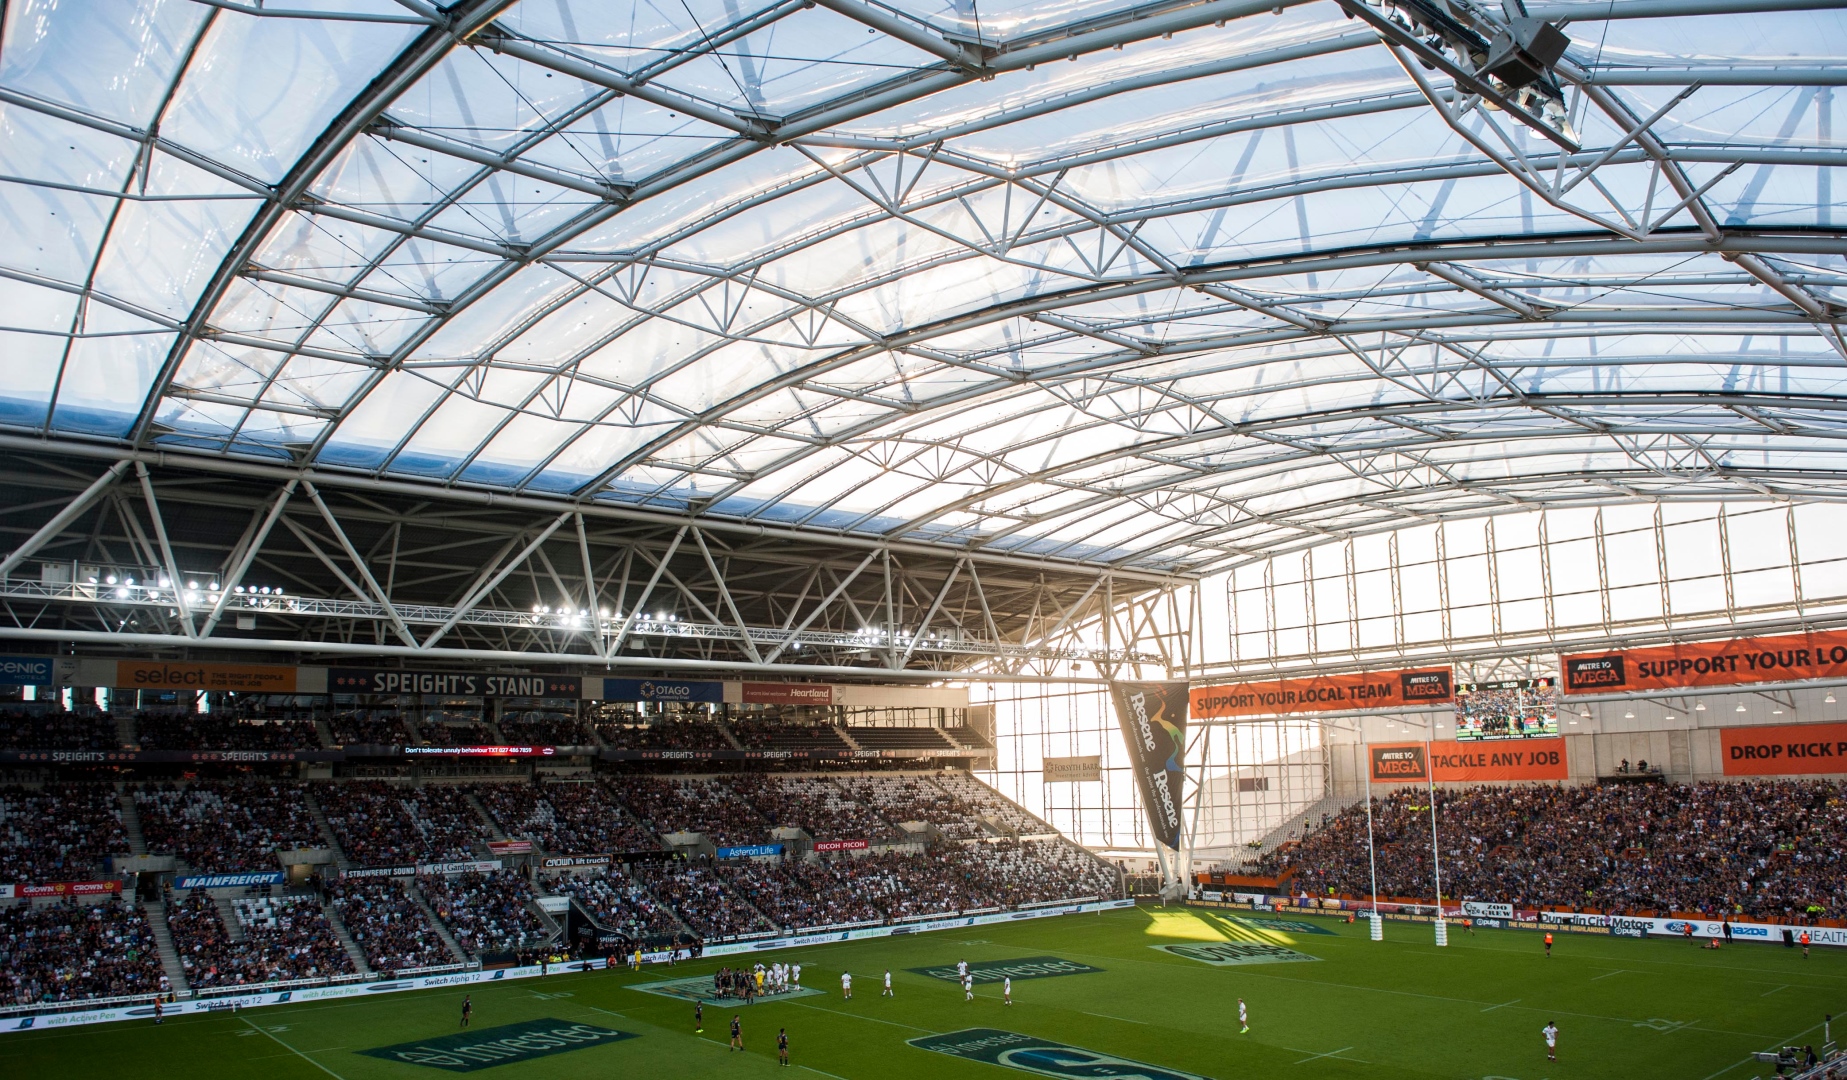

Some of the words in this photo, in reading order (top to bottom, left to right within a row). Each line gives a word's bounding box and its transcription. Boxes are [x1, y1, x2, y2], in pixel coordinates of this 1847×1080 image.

[1577, 662, 1601, 671] MITRE
[1602, 661, 1611, 669] 10
[1638, 655, 1739, 679] SUPPORT
[1743, 649, 1812, 671] YOUR
[134, 665, 206, 685] select
[1410, 676, 1430, 684] MITRE
[1431, 675, 1439, 683] 10
[1572, 669, 1620, 685] MEGA
[373, 672, 477, 695] SPEIGHT'S
[486, 676, 545, 696] STAND
[1405, 683, 1446, 697] MEGA
[1471, 684, 1477, 692] 3
[1527, 679, 1534, 687] 7
[656, 686, 690, 695] OTAGO
[790, 688, 829, 698] Heartland
[1197, 694, 1255, 711] SUPPORT
[1259, 691, 1296, 706] YOUR
[1299, 686, 1346, 702] LOCAL
[1349, 682, 1392, 700] TEAM
[1130, 691, 1156, 752] Resene
[52, 752, 105, 762] SPEIGHT'S
[221, 752, 268, 762] SPEIGHT'S
[661, 751, 694, 759] SPEIGHT'S
[762, 751, 792, 759] SPEIGHT'S
[854, 750, 880, 758] SPEIGHT'S
[1381, 752, 1404, 760] MITRE
[1404, 751, 1414, 759] 10
[1731, 744, 1783, 760] DROP
[1787, 742, 1831, 758] KICK
[1431, 753, 1487, 768] TACKLE
[1491, 753, 1522, 767] ANY
[1527, 751, 1560, 766] JOB
[1378, 760, 1421, 774] MEGA
[1153, 769, 1178, 829] Resene
[729, 848, 758, 857] Asteron
[760, 846, 774, 855] Life
[818, 842, 841, 850] RICOH
[843, 841, 865, 849] RICOH
[447, 863, 476, 872] Gardner
[546, 858, 574, 867] CROWN
[575, 857, 586, 865] lift
[587, 856, 609, 864] trucks
[348, 868, 392, 878] STRAWBERRY
[393, 866, 415, 876] SOUND
[182, 873, 279, 888] MAINFREIGHT
[23, 885, 54, 893] CROWN
[73, 883, 104, 891] CROWN
[1481, 909, 1511, 917] CREW
[1482, 918, 1500, 927] pulse
[1542, 913, 1586, 925] Dundin
[1588, 915, 1611, 927] Cit
[1612, 918, 1654, 929] Motors
[1539, 923, 1558, 931] BEHIND
[1571, 925, 1610, 934] HIGHLANDERS
[1621, 926, 1641, 936] pulse
[793, 937, 811, 945] Switch
[811, 936, 826, 945] Alpha
[970, 961, 1091, 981] Investec
[302, 988, 319, 999] with
[321, 987, 343, 998] Active
[345, 986, 358, 995] Pen
[424, 976, 448, 987] Switch
[449, 975, 471, 986] Alpha
[472, 974, 480, 982] 12
[513, 969, 527, 977] with
[48, 1014, 67, 1025] with
[69, 1012, 97, 1024] Active
[99, 1011, 116, 1021] Pen
[195, 999, 224, 1010] Switch
[251, 996, 262, 1004] 12
[453, 1025, 619, 1062] Investec
[955, 1033, 1032, 1053] Investec
